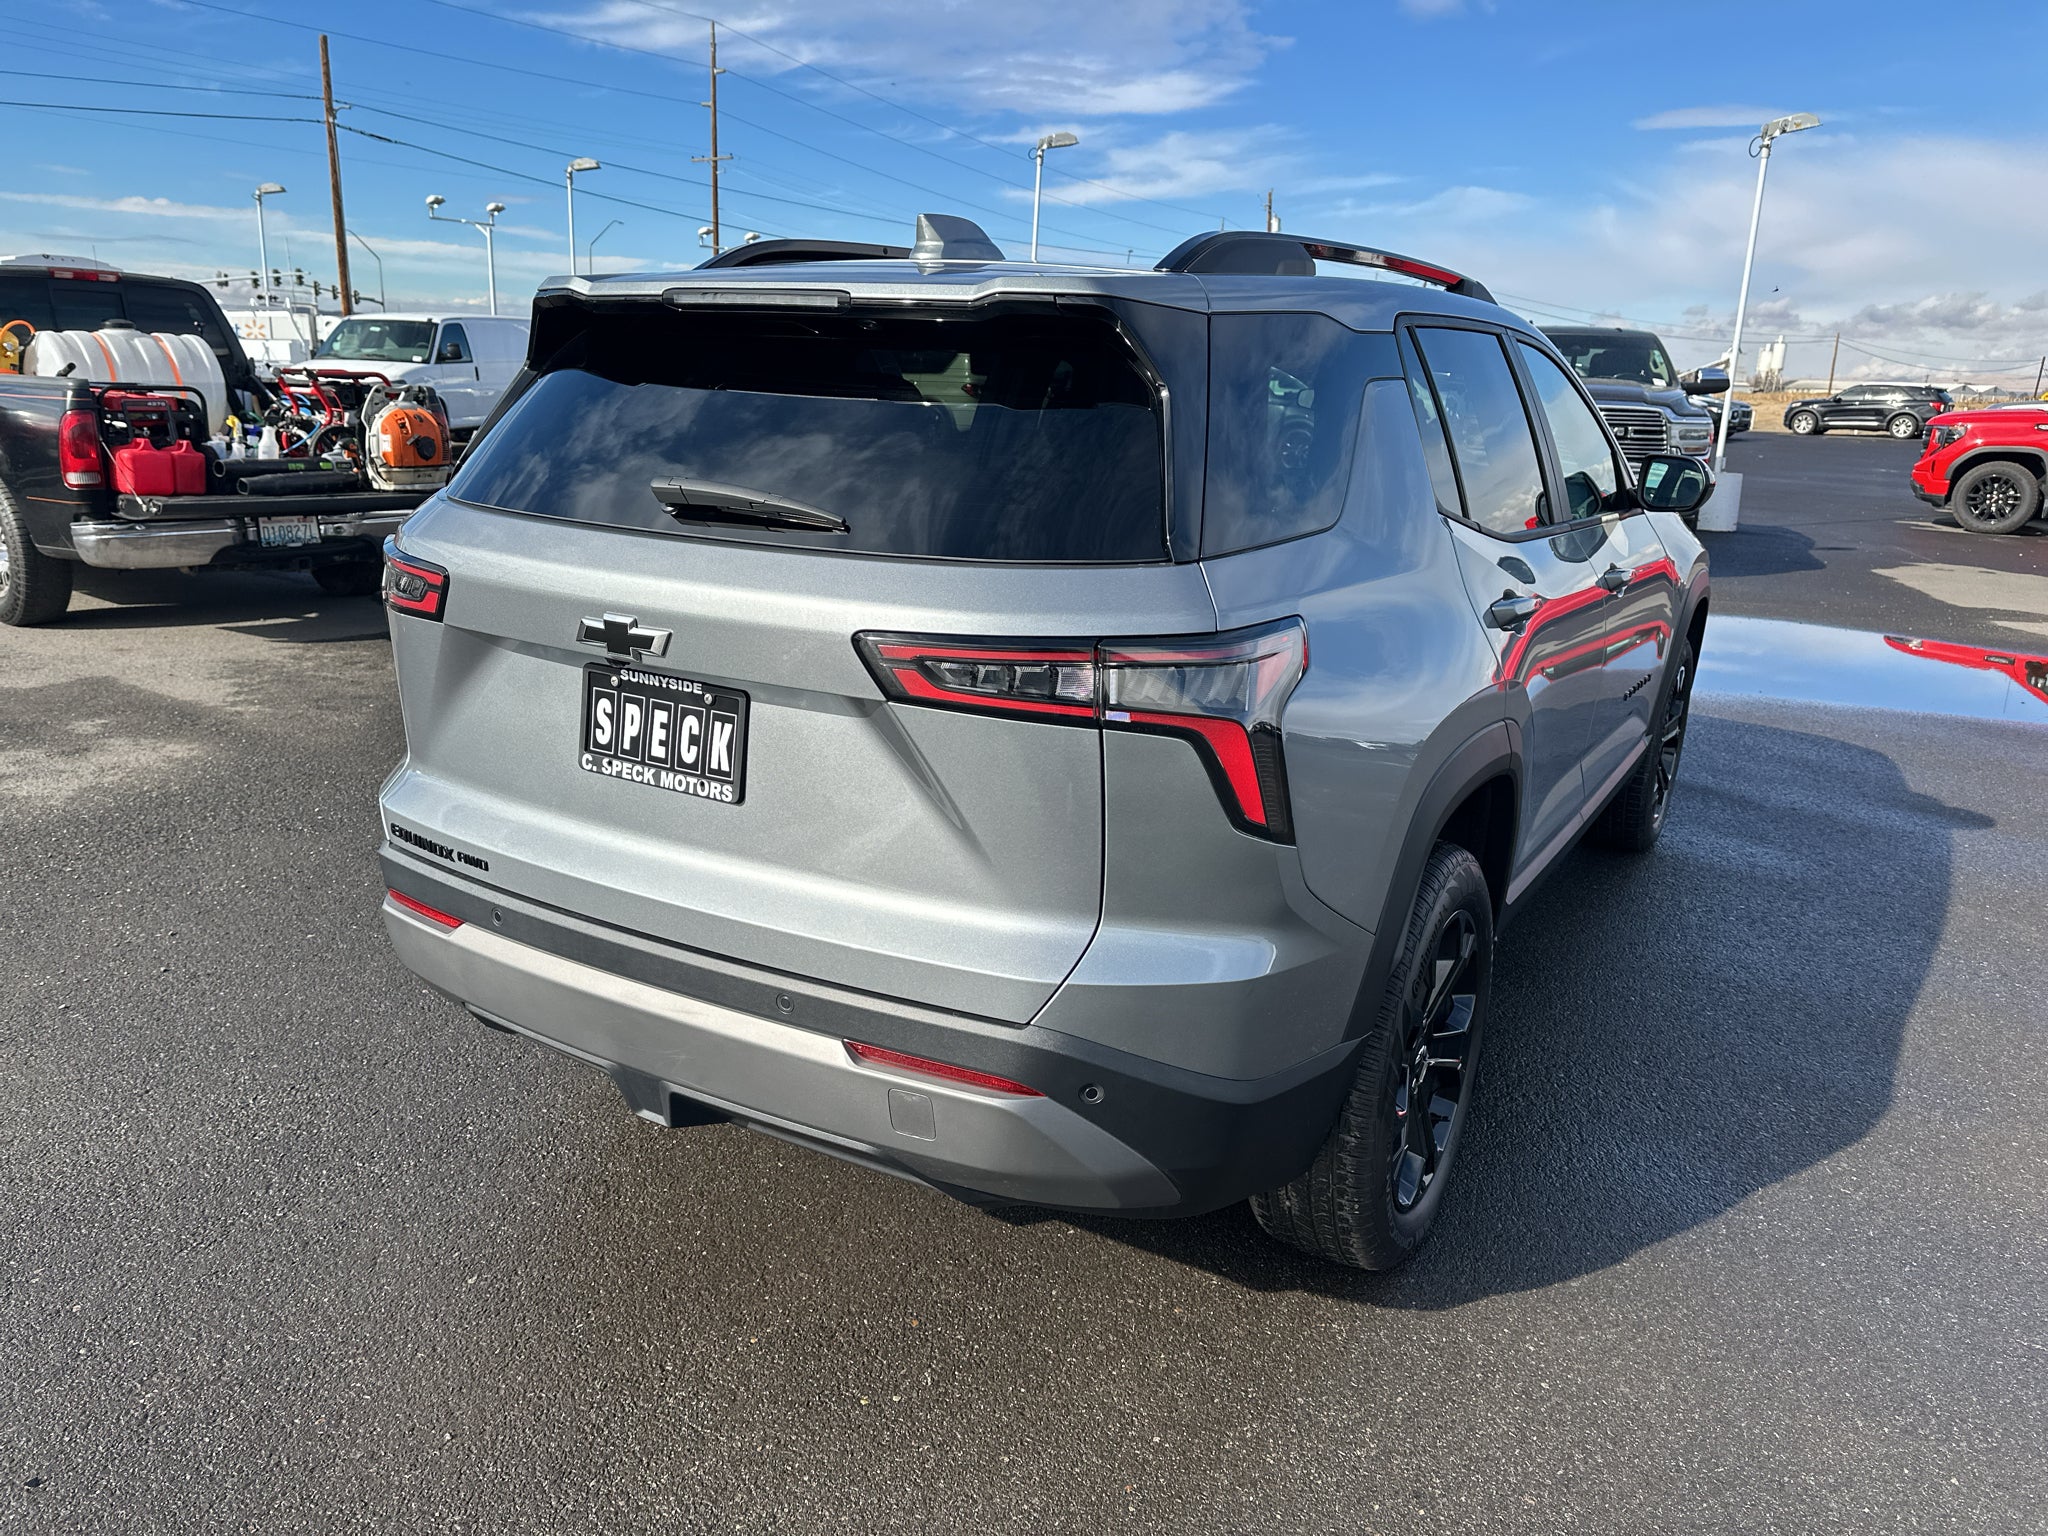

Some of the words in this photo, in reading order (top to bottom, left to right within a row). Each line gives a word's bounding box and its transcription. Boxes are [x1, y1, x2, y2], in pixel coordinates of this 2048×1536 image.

[619, 668, 703, 695] SUNNYSIDE
[594, 697, 734, 772] SPECK
[581, 753, 597, 772] C.
[601, 758, 656, 786] SPECK
[659, 771, 734, 803] MOTORS
